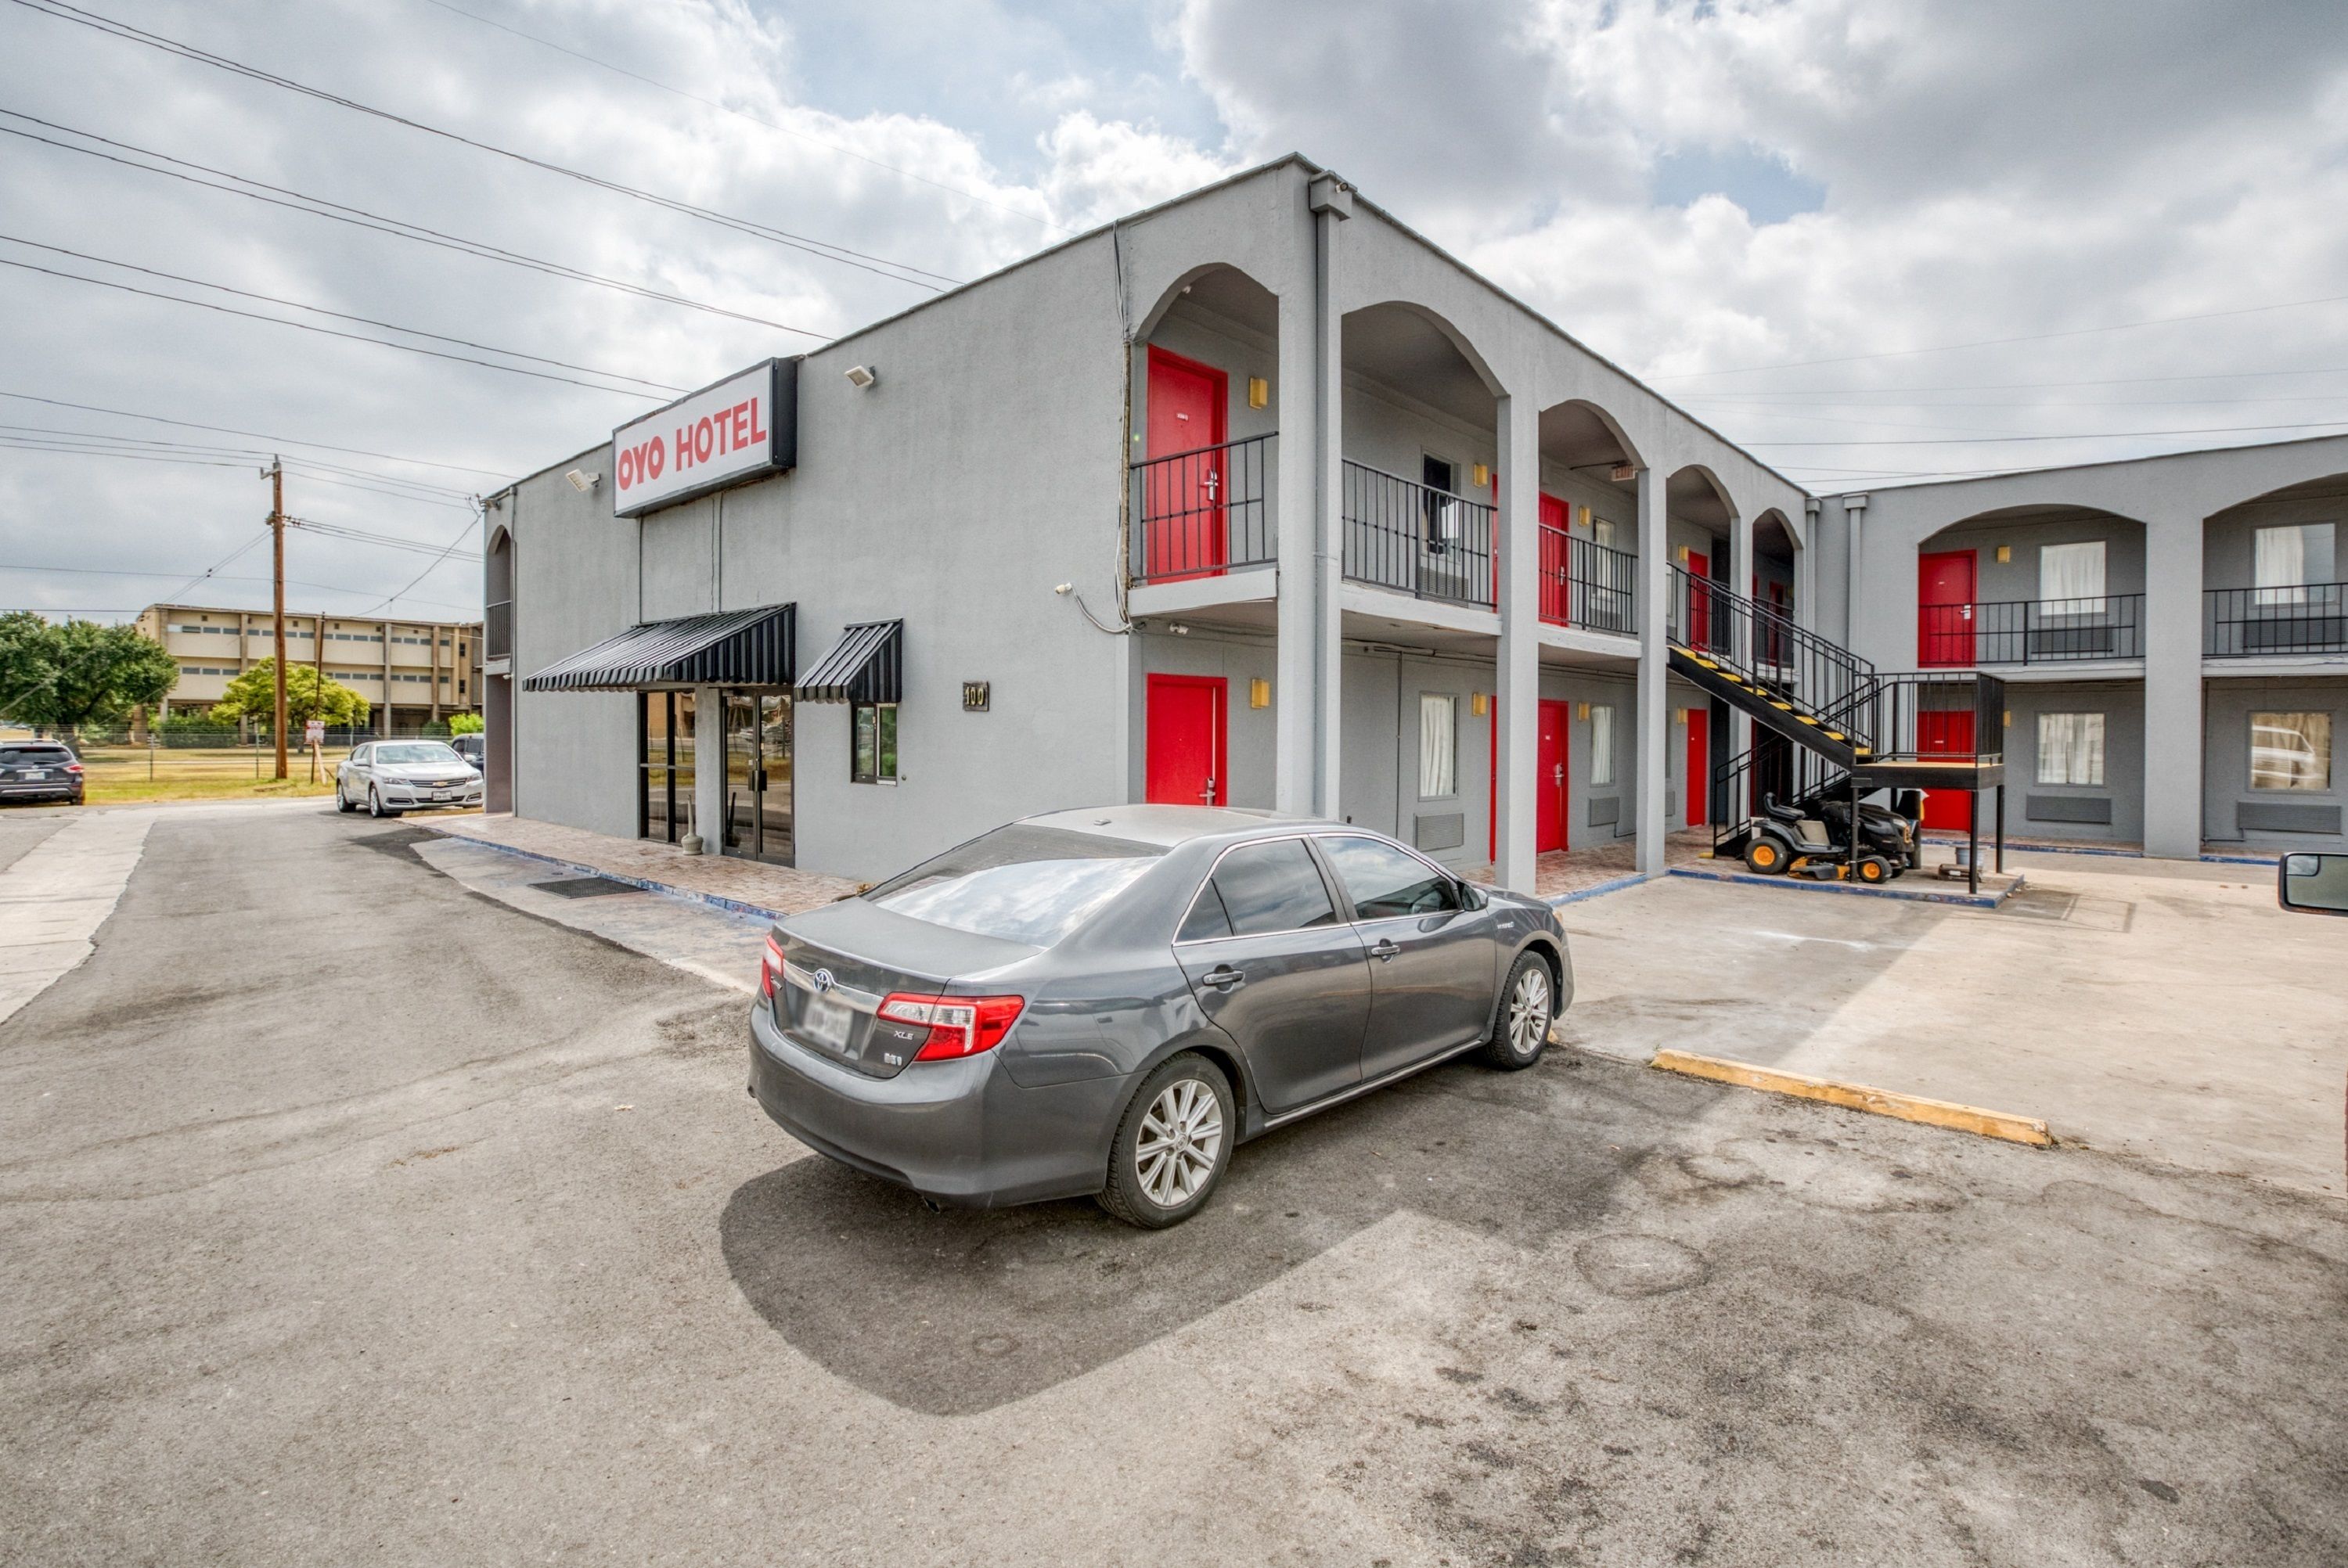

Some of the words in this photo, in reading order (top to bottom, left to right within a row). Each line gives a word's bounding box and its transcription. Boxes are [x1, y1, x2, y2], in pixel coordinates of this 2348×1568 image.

[618, 435, 665, 491] OYO
[675, 397, 767, 472] HOTEL
[964, 686, 984, 706] 100
[894, 1030, 914, 1040] XLE
